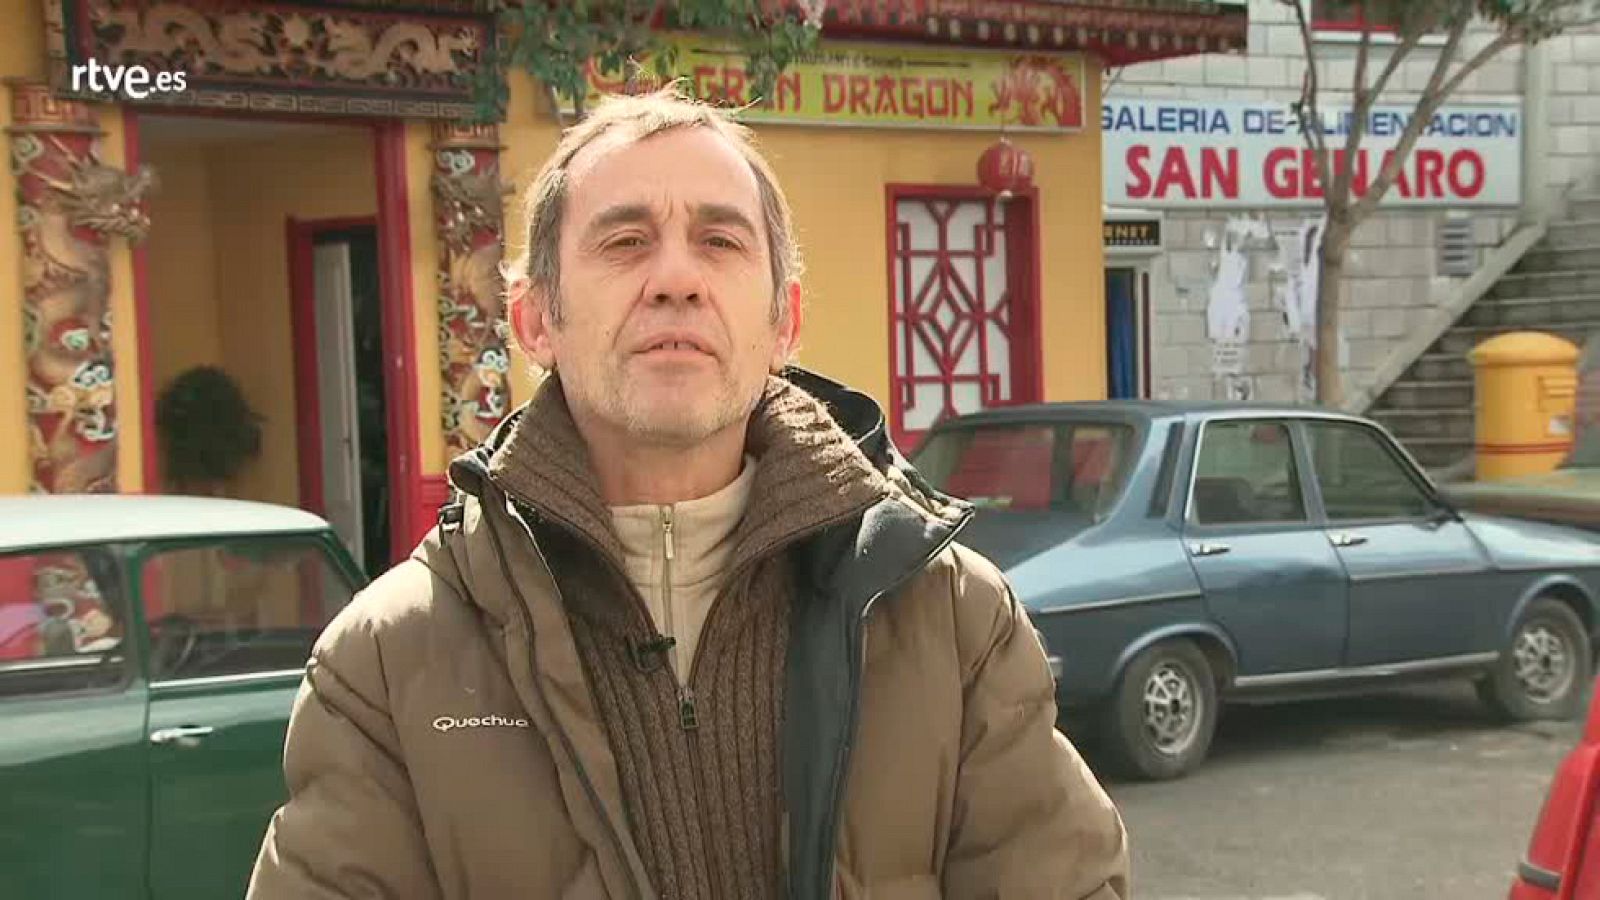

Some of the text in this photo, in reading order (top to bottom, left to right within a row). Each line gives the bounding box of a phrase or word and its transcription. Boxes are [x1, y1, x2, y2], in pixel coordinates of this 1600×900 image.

[693, 65, 974, 119] GRN DRAGON
[1243, 109, 1285, 134] DE
[1299, 111, 1516, 137] LIENACION
[1125, 144, 1239, 199] SAN
[432, 714, 529, 733] Quechua
